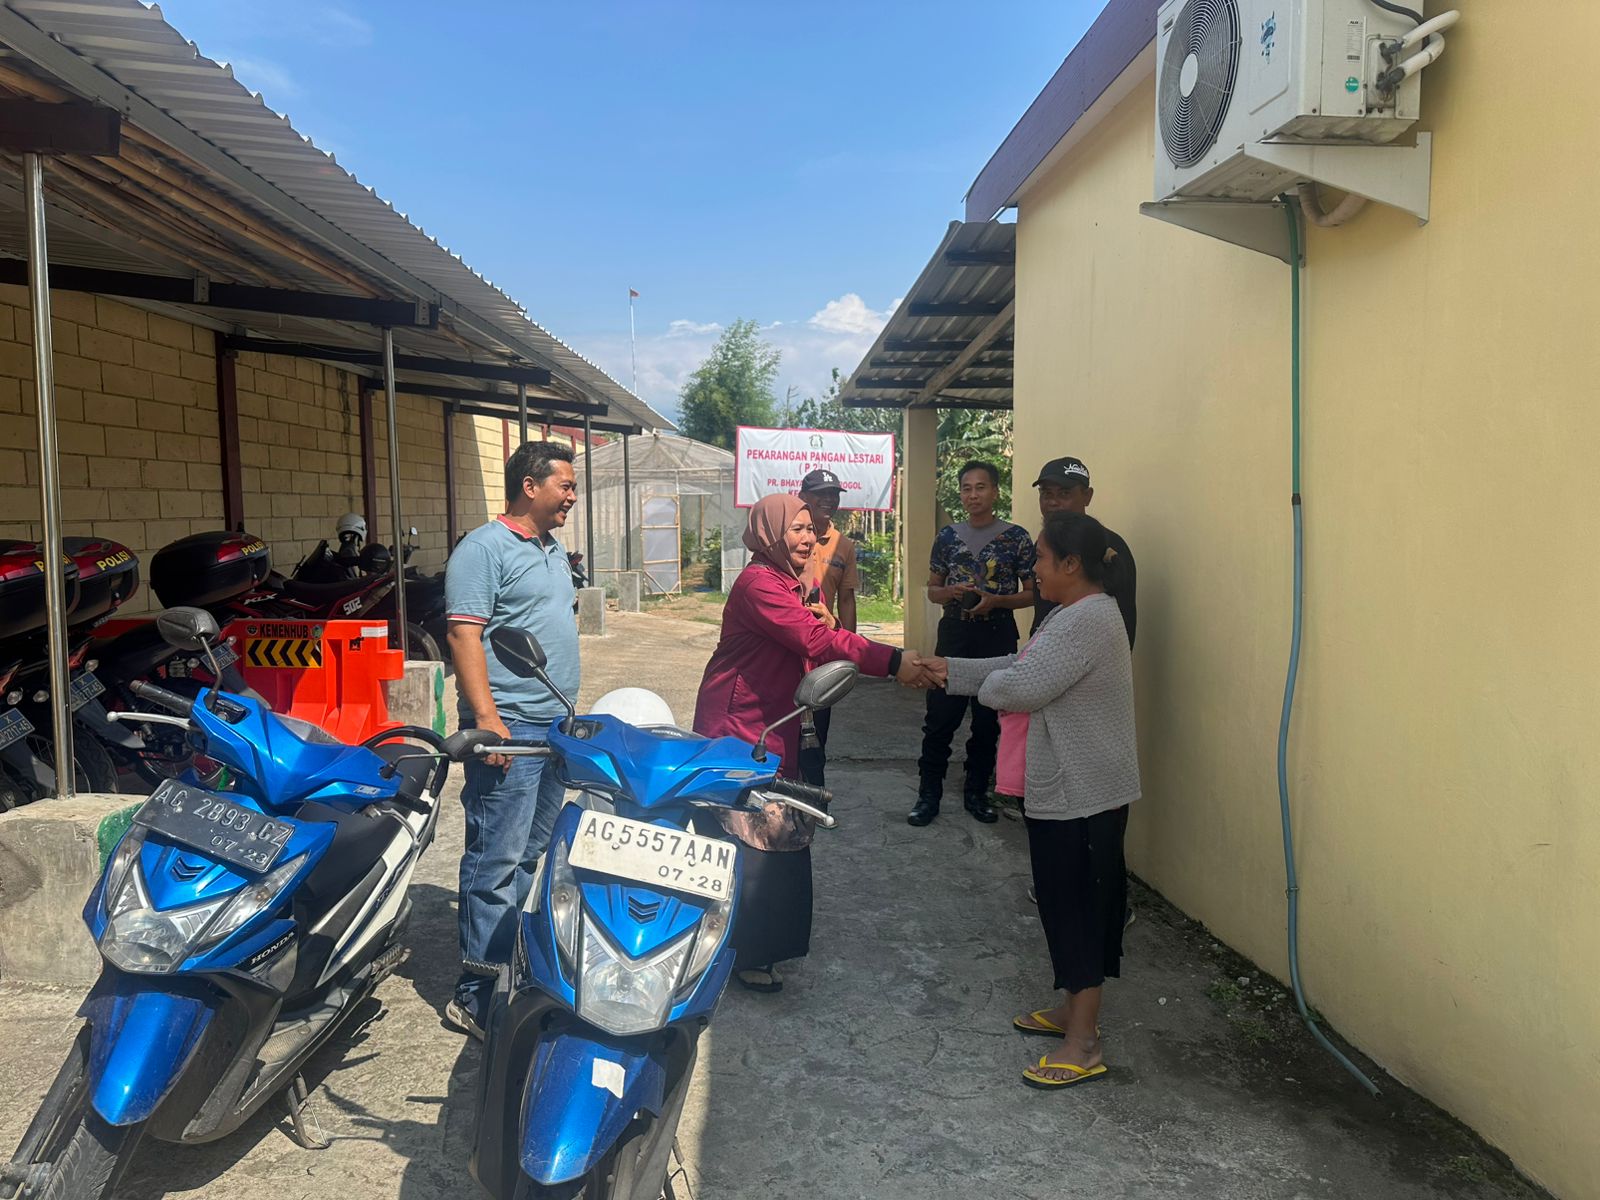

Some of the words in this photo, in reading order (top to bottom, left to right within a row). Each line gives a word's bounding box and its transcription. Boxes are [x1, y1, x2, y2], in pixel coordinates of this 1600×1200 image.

[746, 449, 807, 462] PEKARANGAN
[810, 452, 846, 463] PANGAN
[848, 454, 884, 465] LESTARI
[96, 550, 132, 571] POLISI
[342, 596, 363, 616] 502
[259, 624, 309, 639] KEMENHUB
[155, 785, 189, 807] AG
[193, 798, 251, 832] 2893
[258, 821, 292, 848] CZ
[584, 817, 616, 842] AG
[618, 824, 682, 856] 5557
[684, 839, 730, 870] AAN
[250, 931, 295, 966] HONDA
